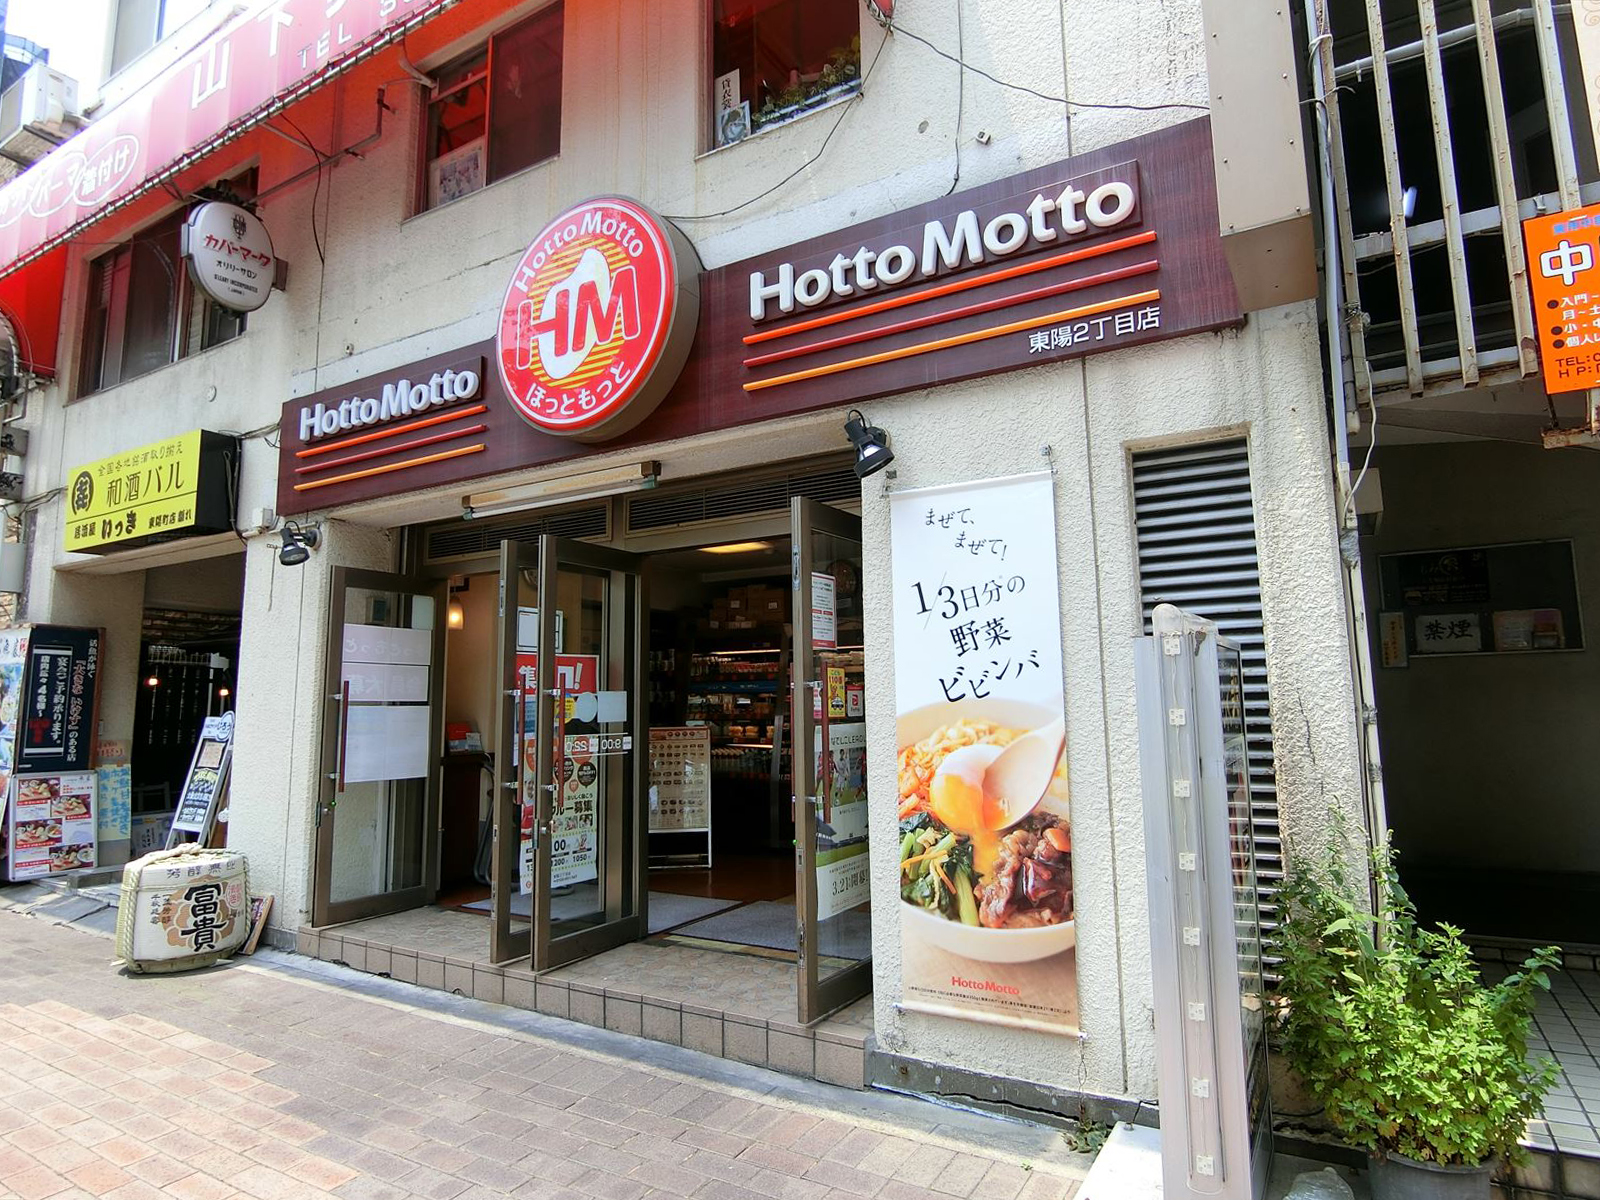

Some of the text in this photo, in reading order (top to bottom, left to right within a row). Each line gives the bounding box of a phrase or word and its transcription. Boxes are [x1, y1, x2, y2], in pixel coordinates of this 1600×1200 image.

[299, 23, 352, 69] TEL
[204, 233, 271, 268] カバーマーク
[1028, 306, 1160, 354] 東陽2丁目店
[526, 361, 631, 416] ほっともっと
[106, 461, 184, 508] 和酒バル
[101, 509, 137, 540] いっき
[950, 617, 1012, 658] 野菜
[1424, 618, 1474, 642] 禁煙
[939, 649, 1040, 702] ビビンバ
